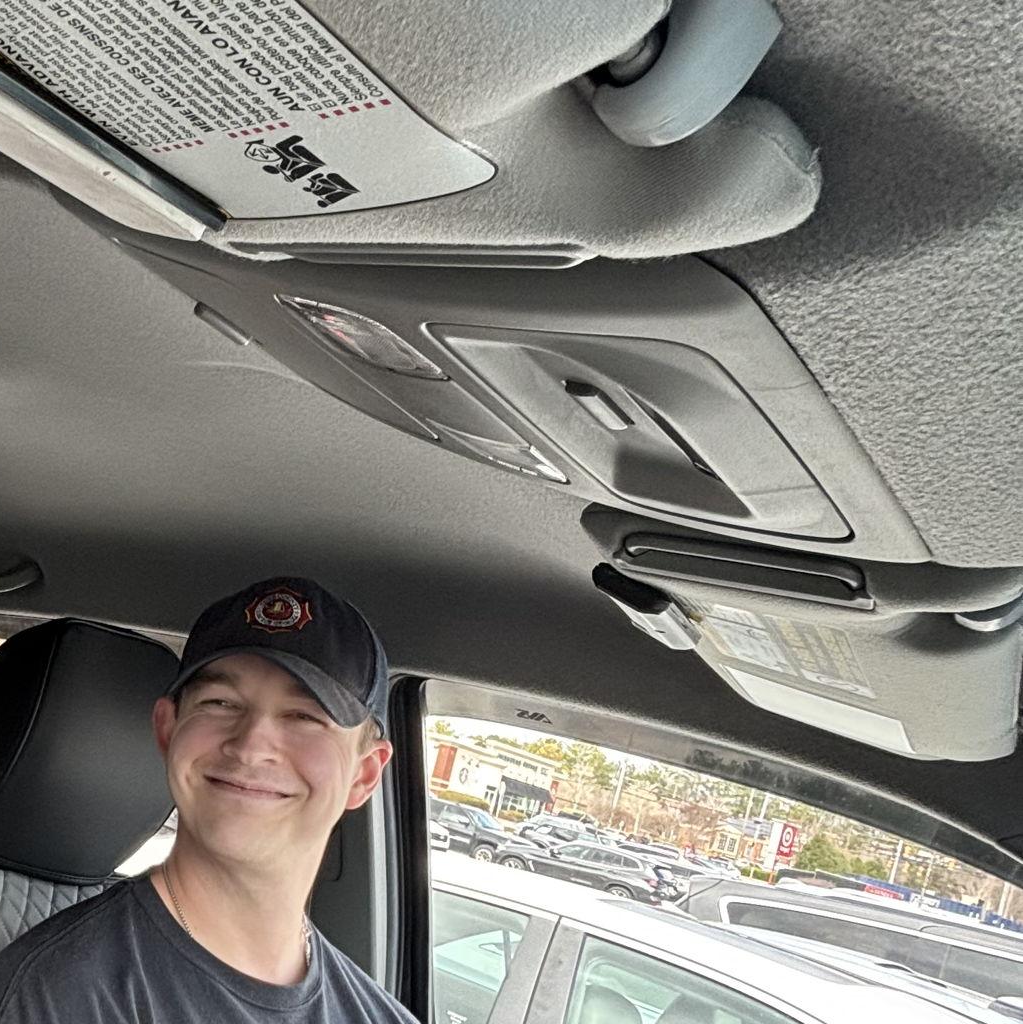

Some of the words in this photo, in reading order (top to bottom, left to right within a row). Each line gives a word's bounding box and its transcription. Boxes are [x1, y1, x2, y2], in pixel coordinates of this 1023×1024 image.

[44, 1, 73, 17] DE
[202, 11, 221, 21] la
[222, 12, 243, 23] el
[230, 0, 268, 25] parte
[276, 5, 304, 22] del
[214, 21, 254, 50] causar
[233, 22, 257, 34] es
[258, 25, 278, 35] la
[259, 9, 308, 44] cinturón
[294, 21, 339, 53] Manual
[63, 17, 133, 66] COUSSINS
[207, 37, 241, 57] LO
[248, 34, 298, 70] posterior
[269, 34, 292, 47] en
[246, 50, 285, 75] puede
[283, 47, 328, 79] coloque
[299, 43, 335, 69] utilice
[328, 53, 349, 63] el
[123, 65, 156, 85] DES
[231, 57, 275, 86] CON
[274, 74, 303, 91] bag
[339, 63, 386, 98] Consulte
[147, 85, 185, 108] AVEC
[288, 70, 328, 99] asiento
[292, 91, 314, 102] air
[318, 79, 354, 104] Nunca
[327, 69, 371, 101] Siempre
[56, 89, 98, 117] WITH
[265, 86, 306, 112] AUN
[305, 102, 324, 111] El
[320, 99, 339, 108] El
[97, 120, 139, 146] EVEN
